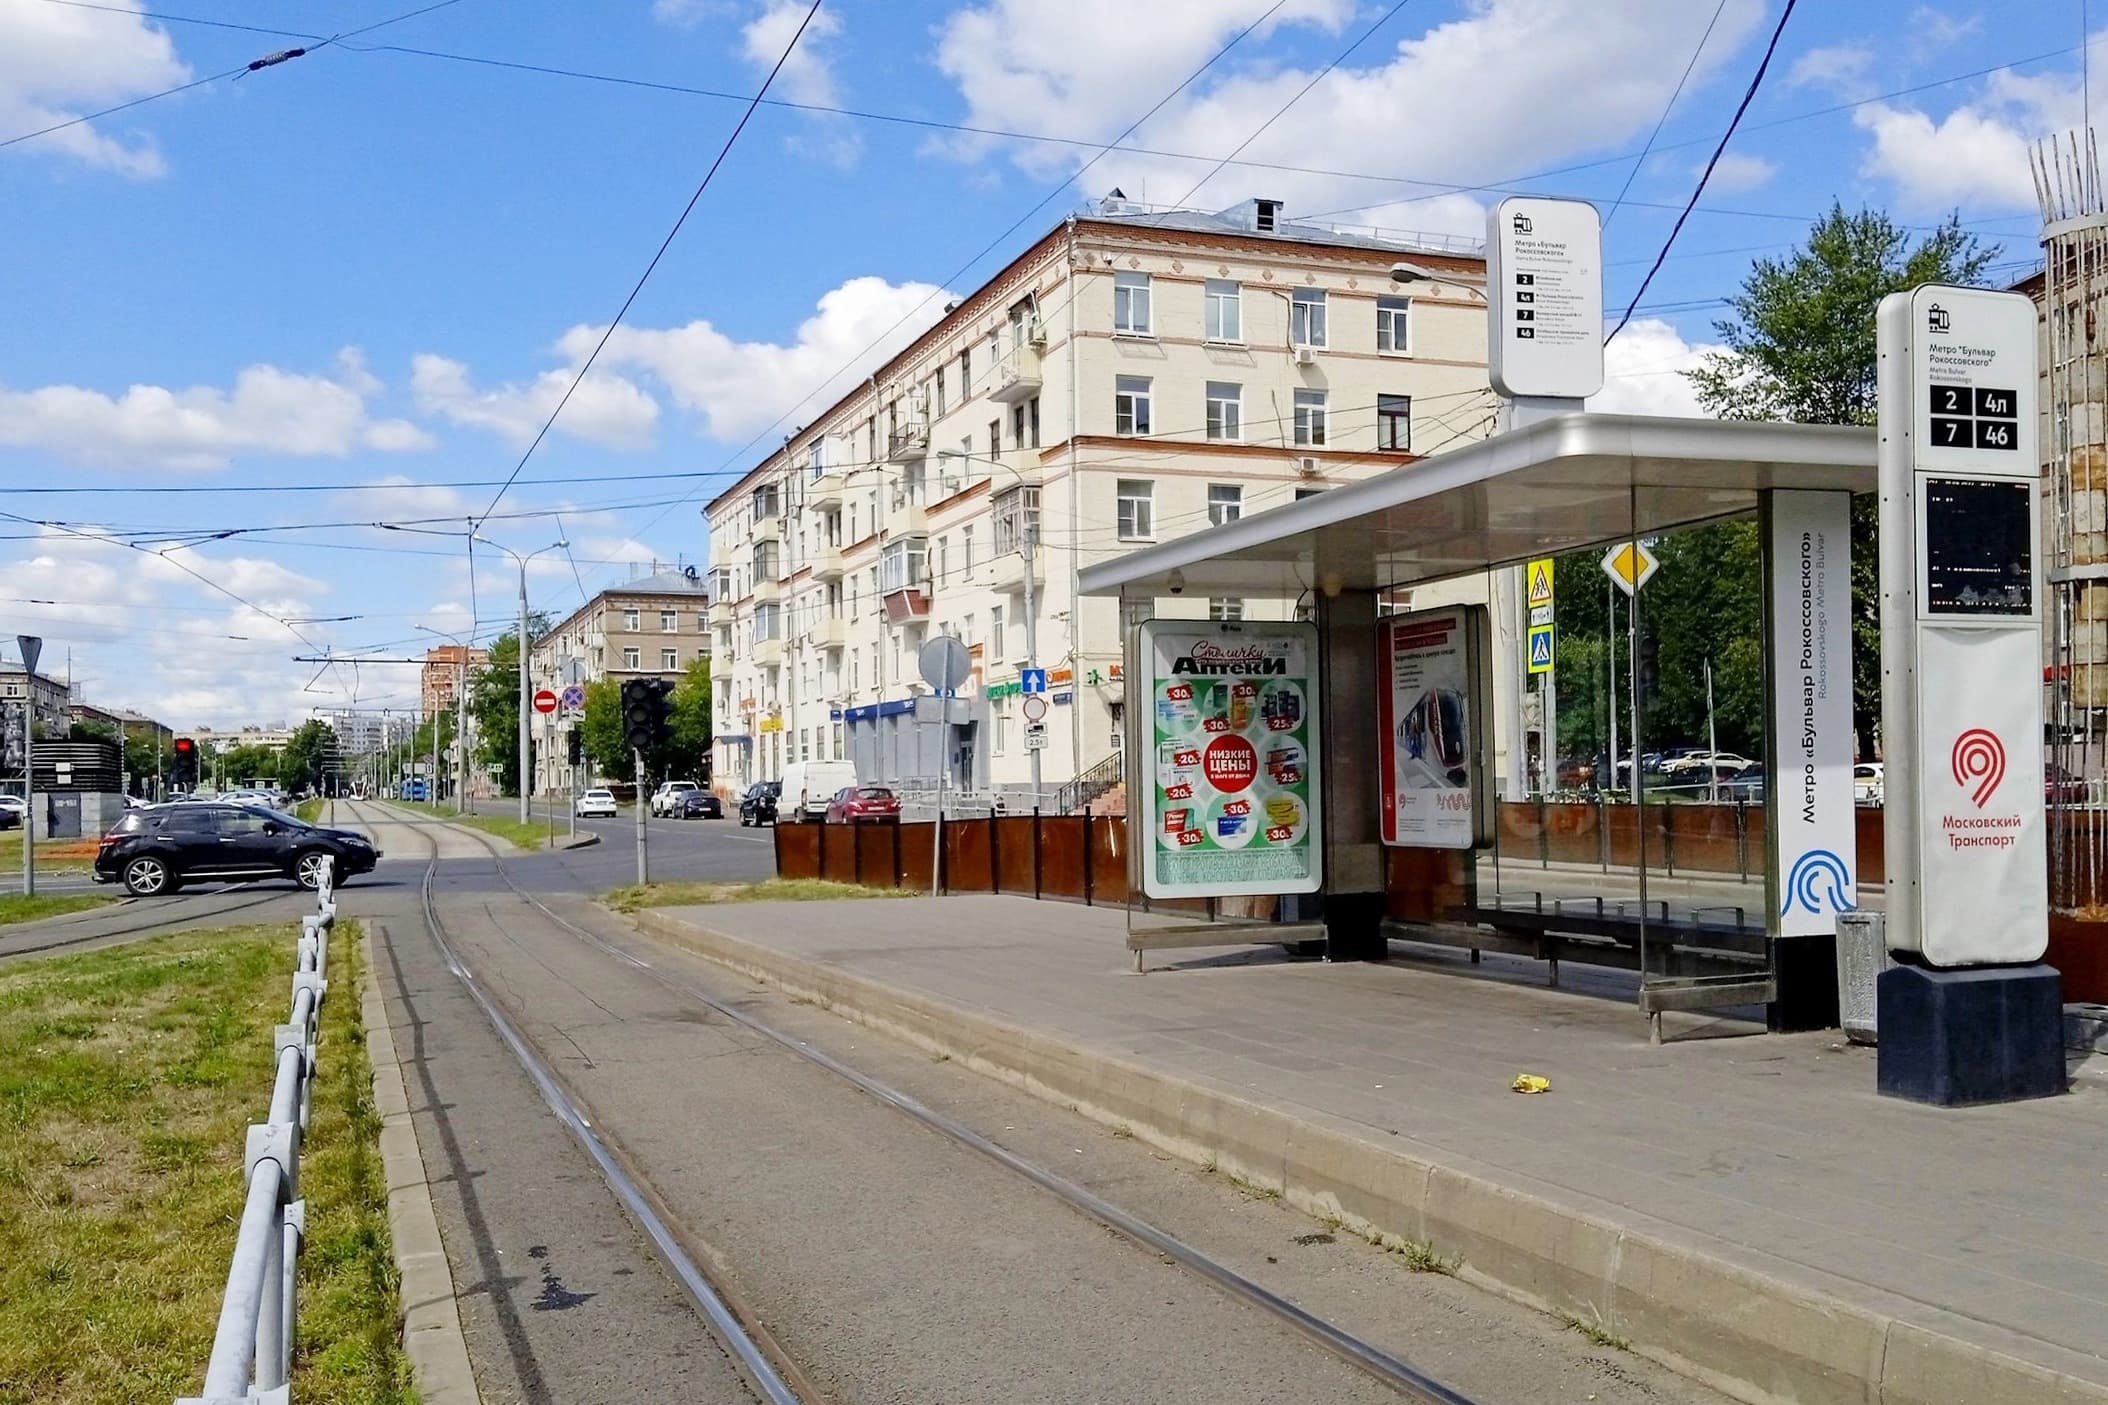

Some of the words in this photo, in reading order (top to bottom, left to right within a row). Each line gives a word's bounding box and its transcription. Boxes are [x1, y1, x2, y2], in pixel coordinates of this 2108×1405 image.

[1522, 276, 1529, 284] 2
[1522, 311, 1529, 319] 7
[1929, 344, 1957, 354] Метро
[1929, 354, 1993, 367] Рокоссовского"
[1945, 391, 1957, 410] 2
[1985, 393, 2007, 413] 4л
[1946, 423, 1957, 442] 7
[1985, 426, 2009, 445] 46
[1814, 532, 1825, 568] Bulvar
[1815, 573, 1825, 607] Metro
[1799, 532, 1813, 669] Рокоссовского»
[1816, 611, 1827, 699] Rokossovskogo
[1801, 676, 1816, 758] «Бульвар
[1209, 750, 1252, 760] НИЗКИЕ
[1210, 760, 1251, 773] ЦЕНЫ
[1802, 764, 1817, 823] Метро
[1942, 814, 2022, 829] Московский
[1948, 833, 2016, 851] Транспорт
